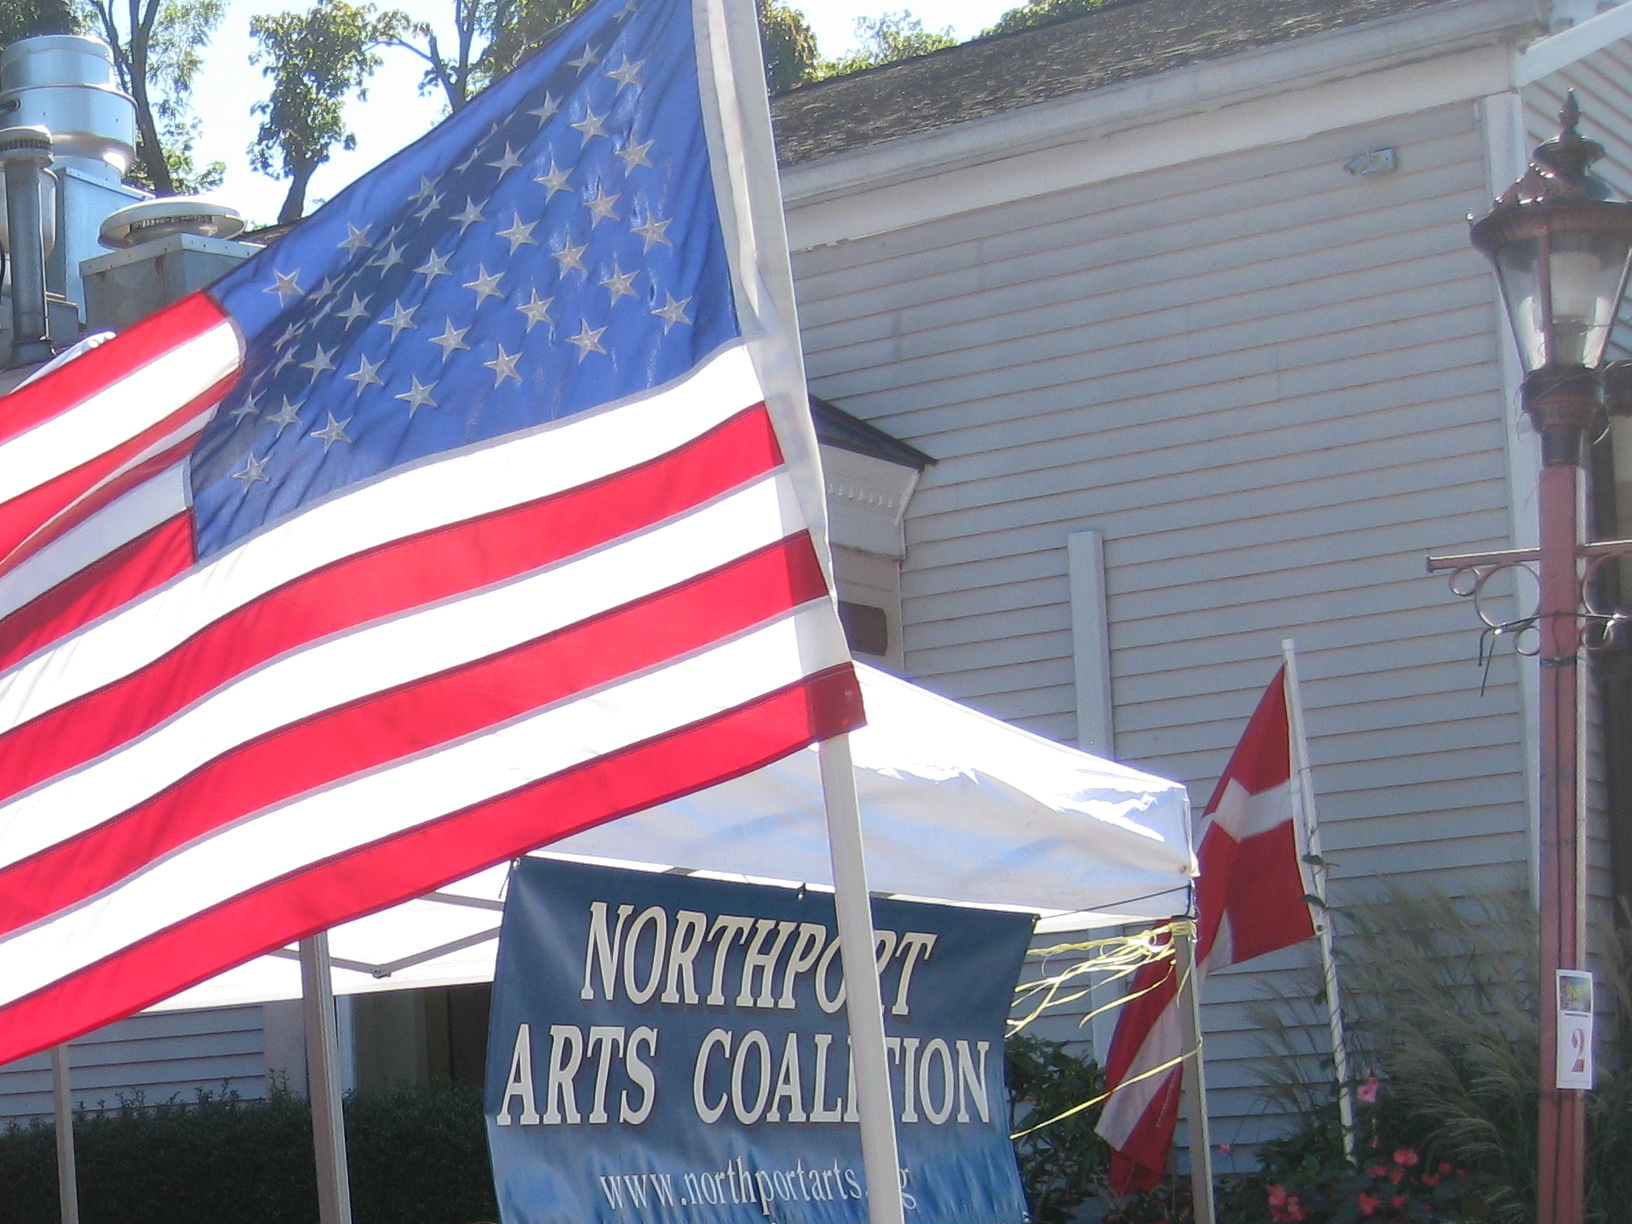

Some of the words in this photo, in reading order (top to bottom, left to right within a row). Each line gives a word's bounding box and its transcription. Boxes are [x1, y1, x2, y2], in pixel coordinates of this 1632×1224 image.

[496, 1024, 658, 1127] ARTS
[1571, 1028, 1585, 1073] 2
[599, 1156, 918, 1215] www.northportarts.g
